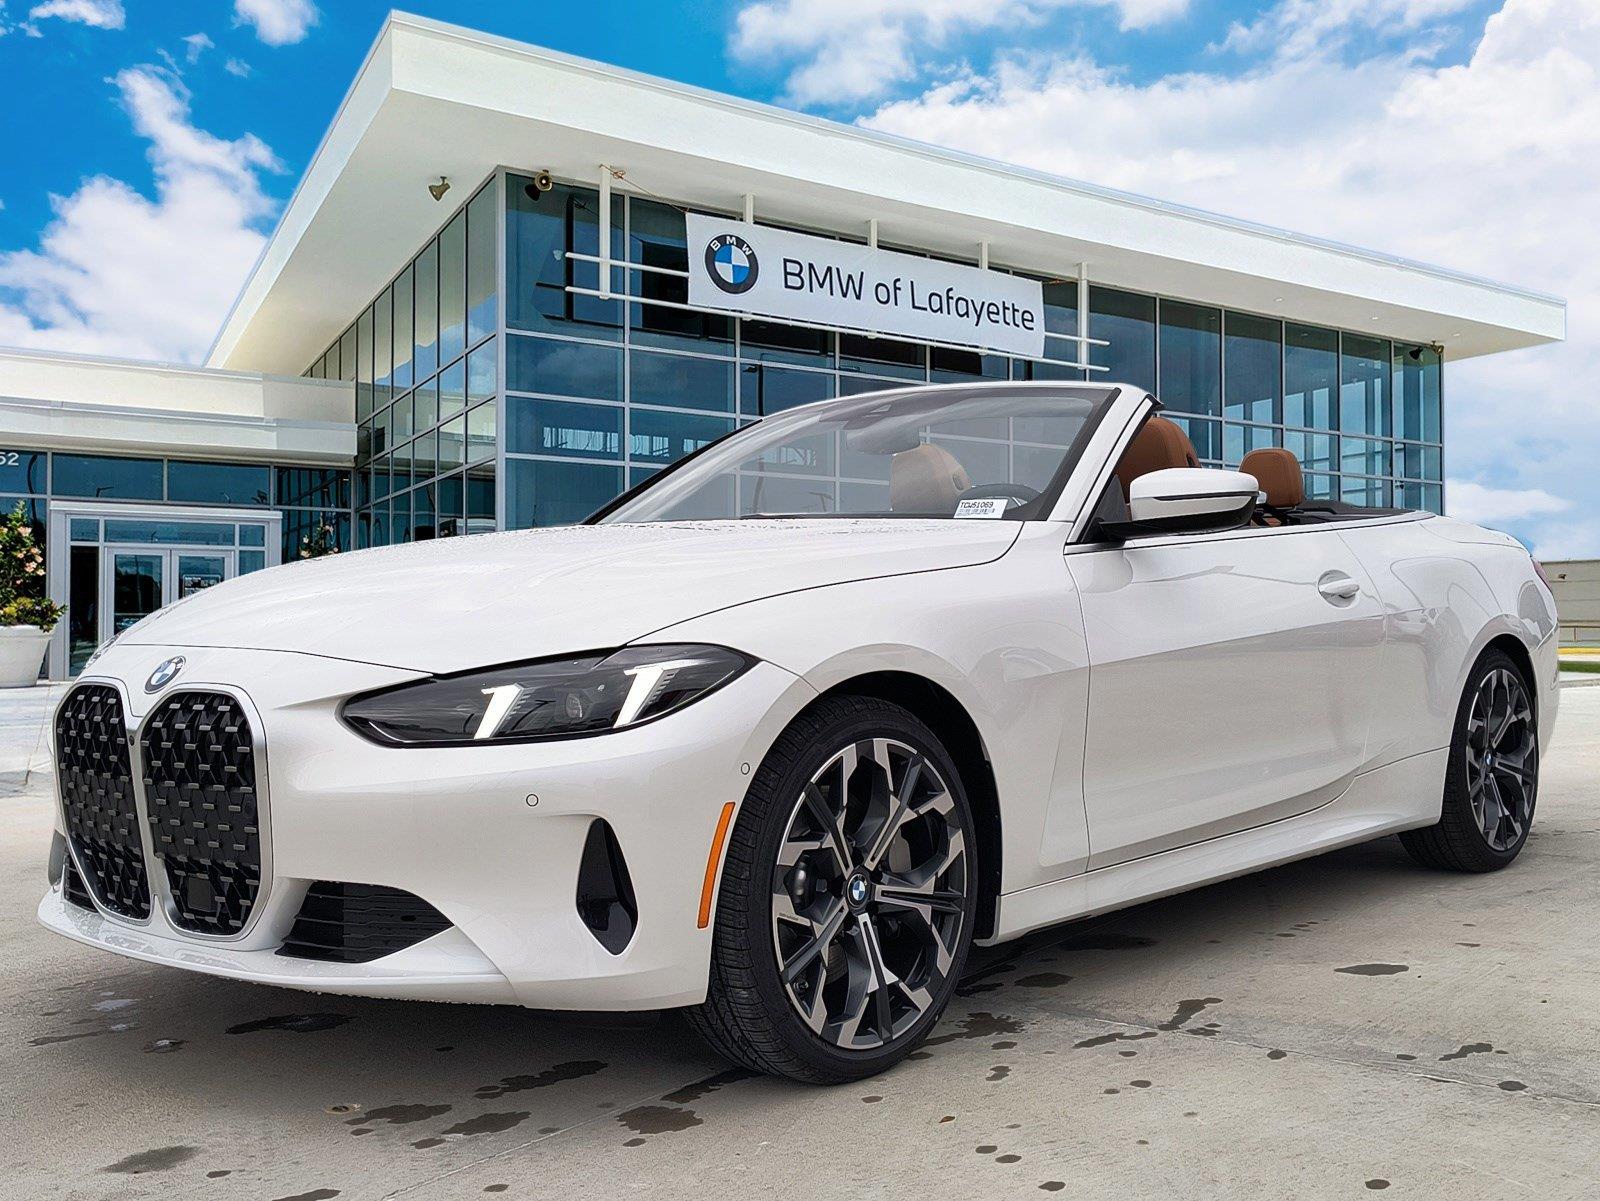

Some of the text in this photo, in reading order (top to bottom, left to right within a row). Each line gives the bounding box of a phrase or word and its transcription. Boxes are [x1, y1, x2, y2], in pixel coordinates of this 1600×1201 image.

[710, 235, 752, 256] BMW
[783, 258, 1035, 330] BMW of Lafayette
